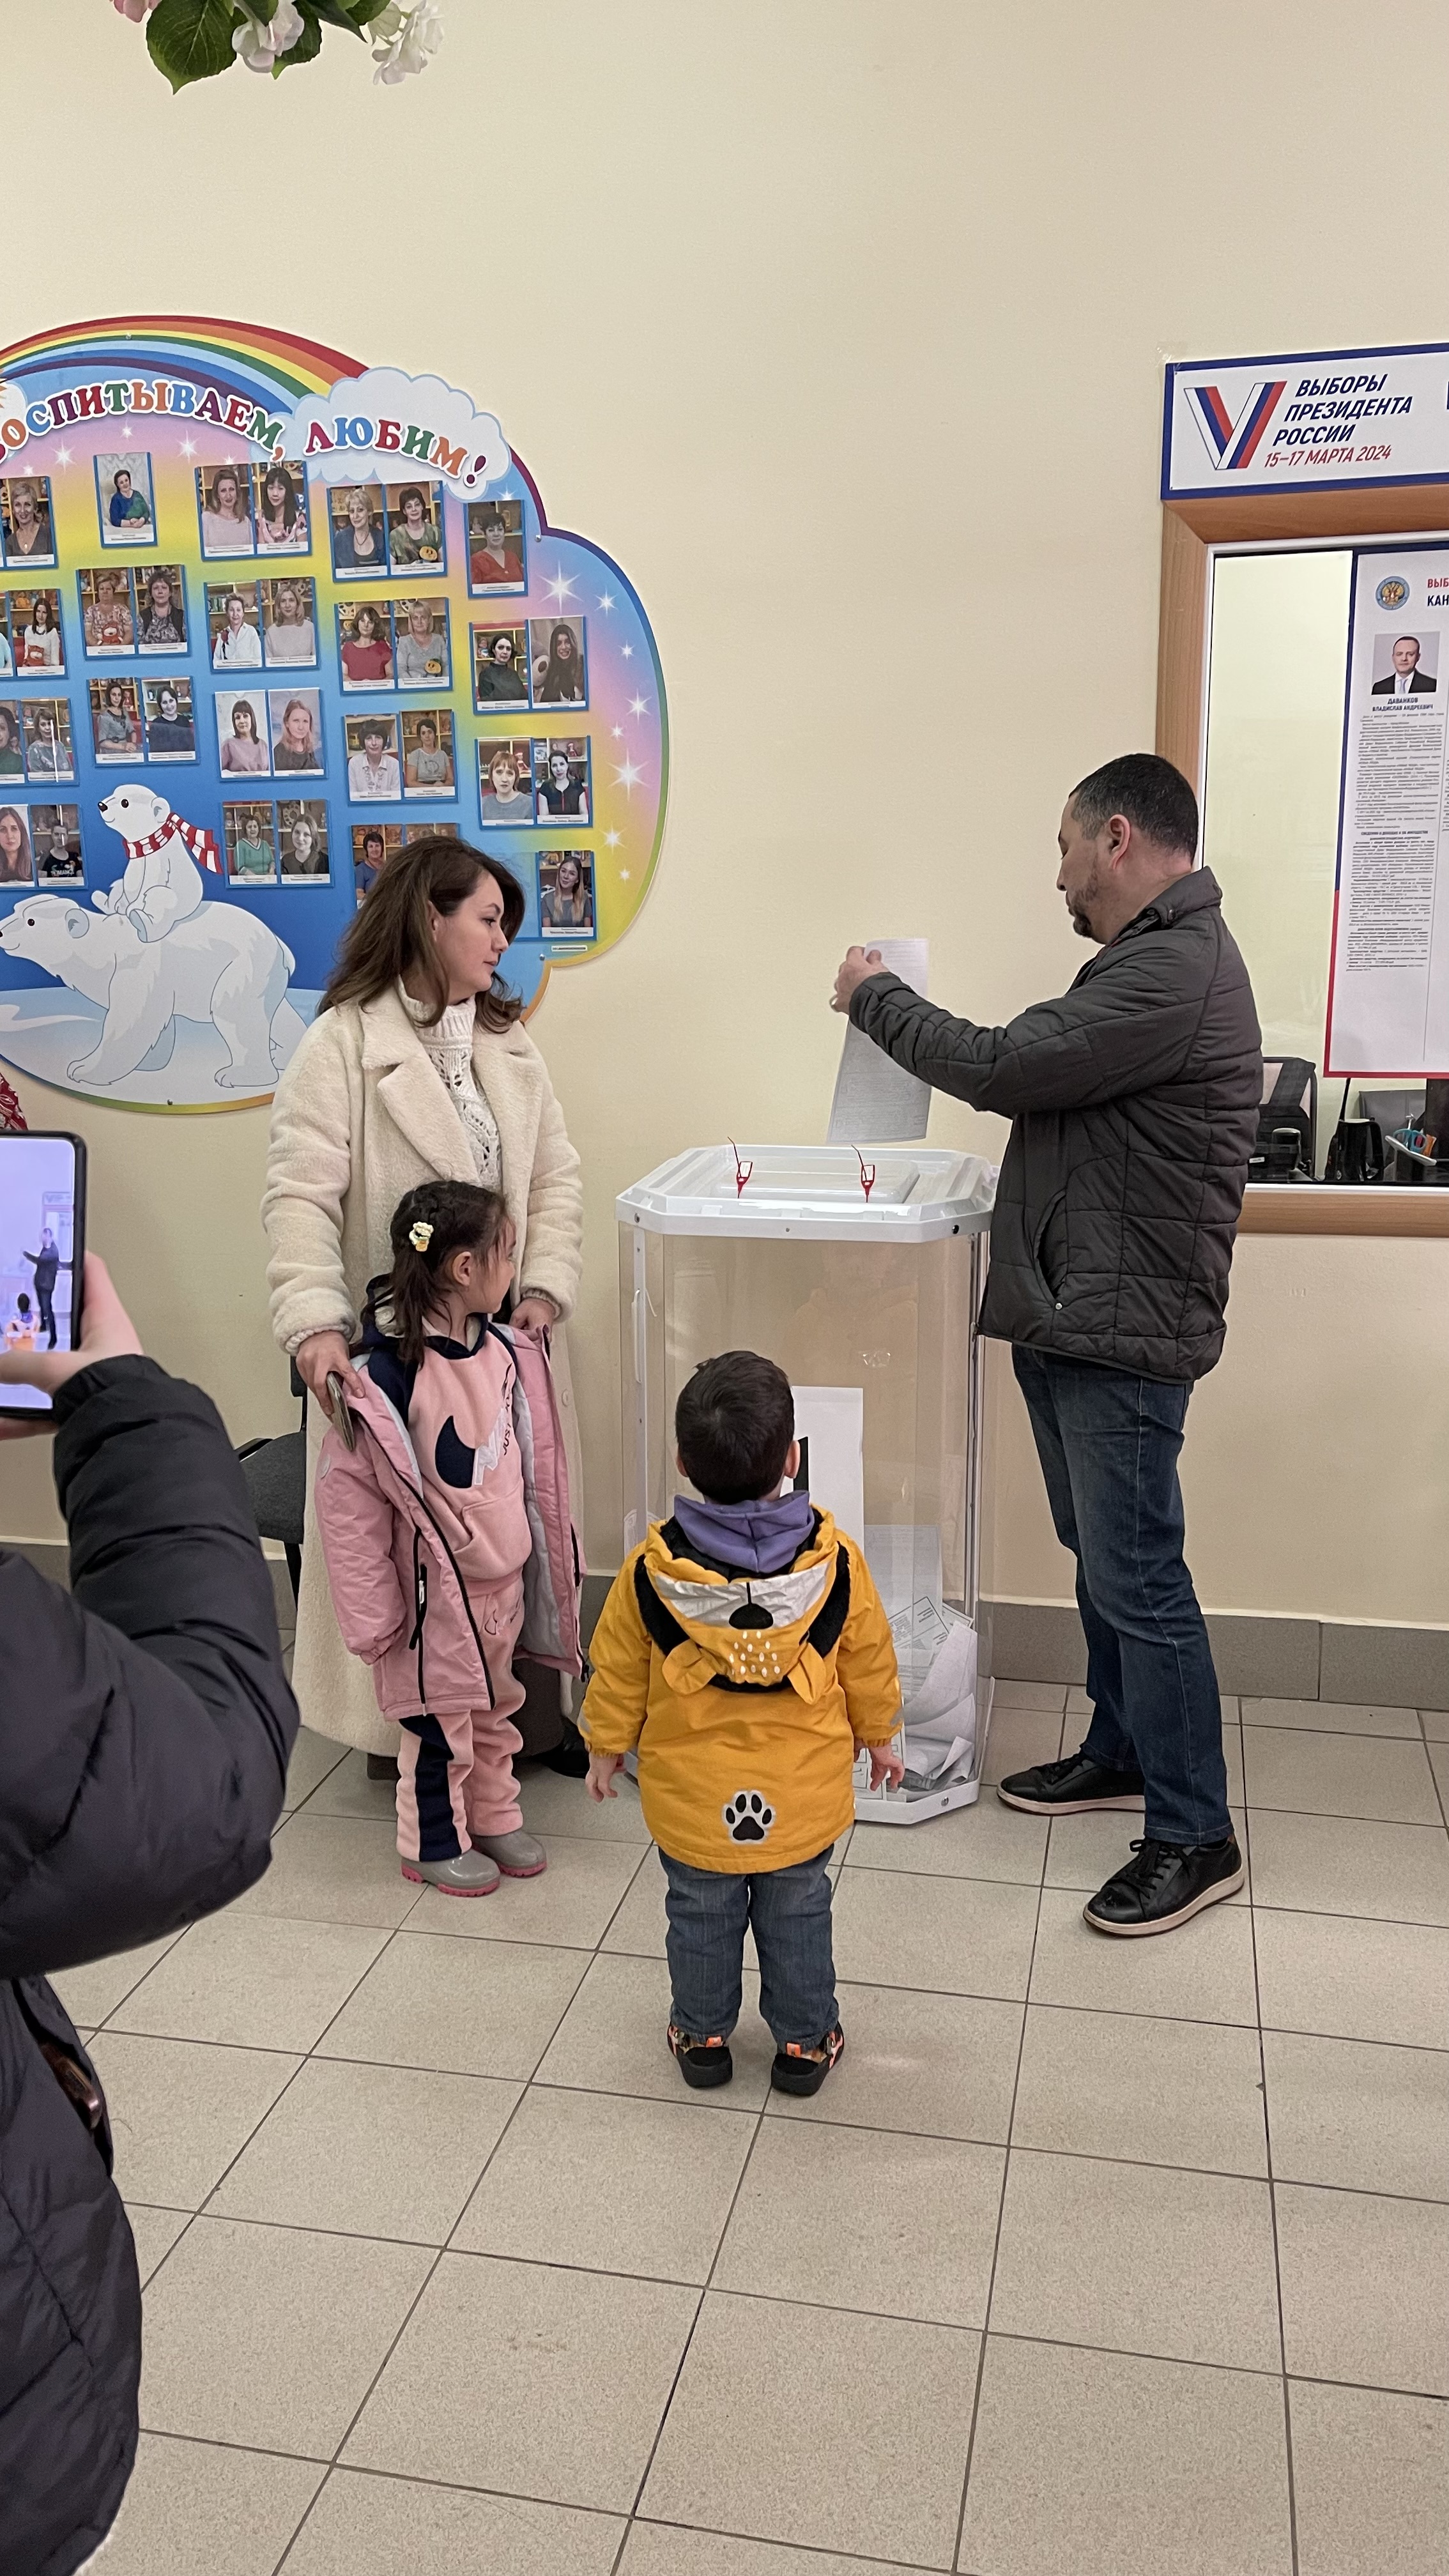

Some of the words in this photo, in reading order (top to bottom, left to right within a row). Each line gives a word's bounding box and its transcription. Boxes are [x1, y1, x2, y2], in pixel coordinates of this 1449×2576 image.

[1295, 374, 1388, 397] ВЫБОРЫ
[1284, 396, 1413, 422] ПРЕЗИДЕНТА
[0, 382, 284, 461] ОСПИТЫВАЕМ,
[305, 417, 486, 484] ЛЮБИМ!
[1272, 424, 1356, 447] РОССИИ
[1304, 447, 1355, 465] МАРТА
[1355, 445, 1392, 462] 2024
[1427, 578, 1449, 588] ВЫБ
[1427, 594, 1449, 606] КАН
